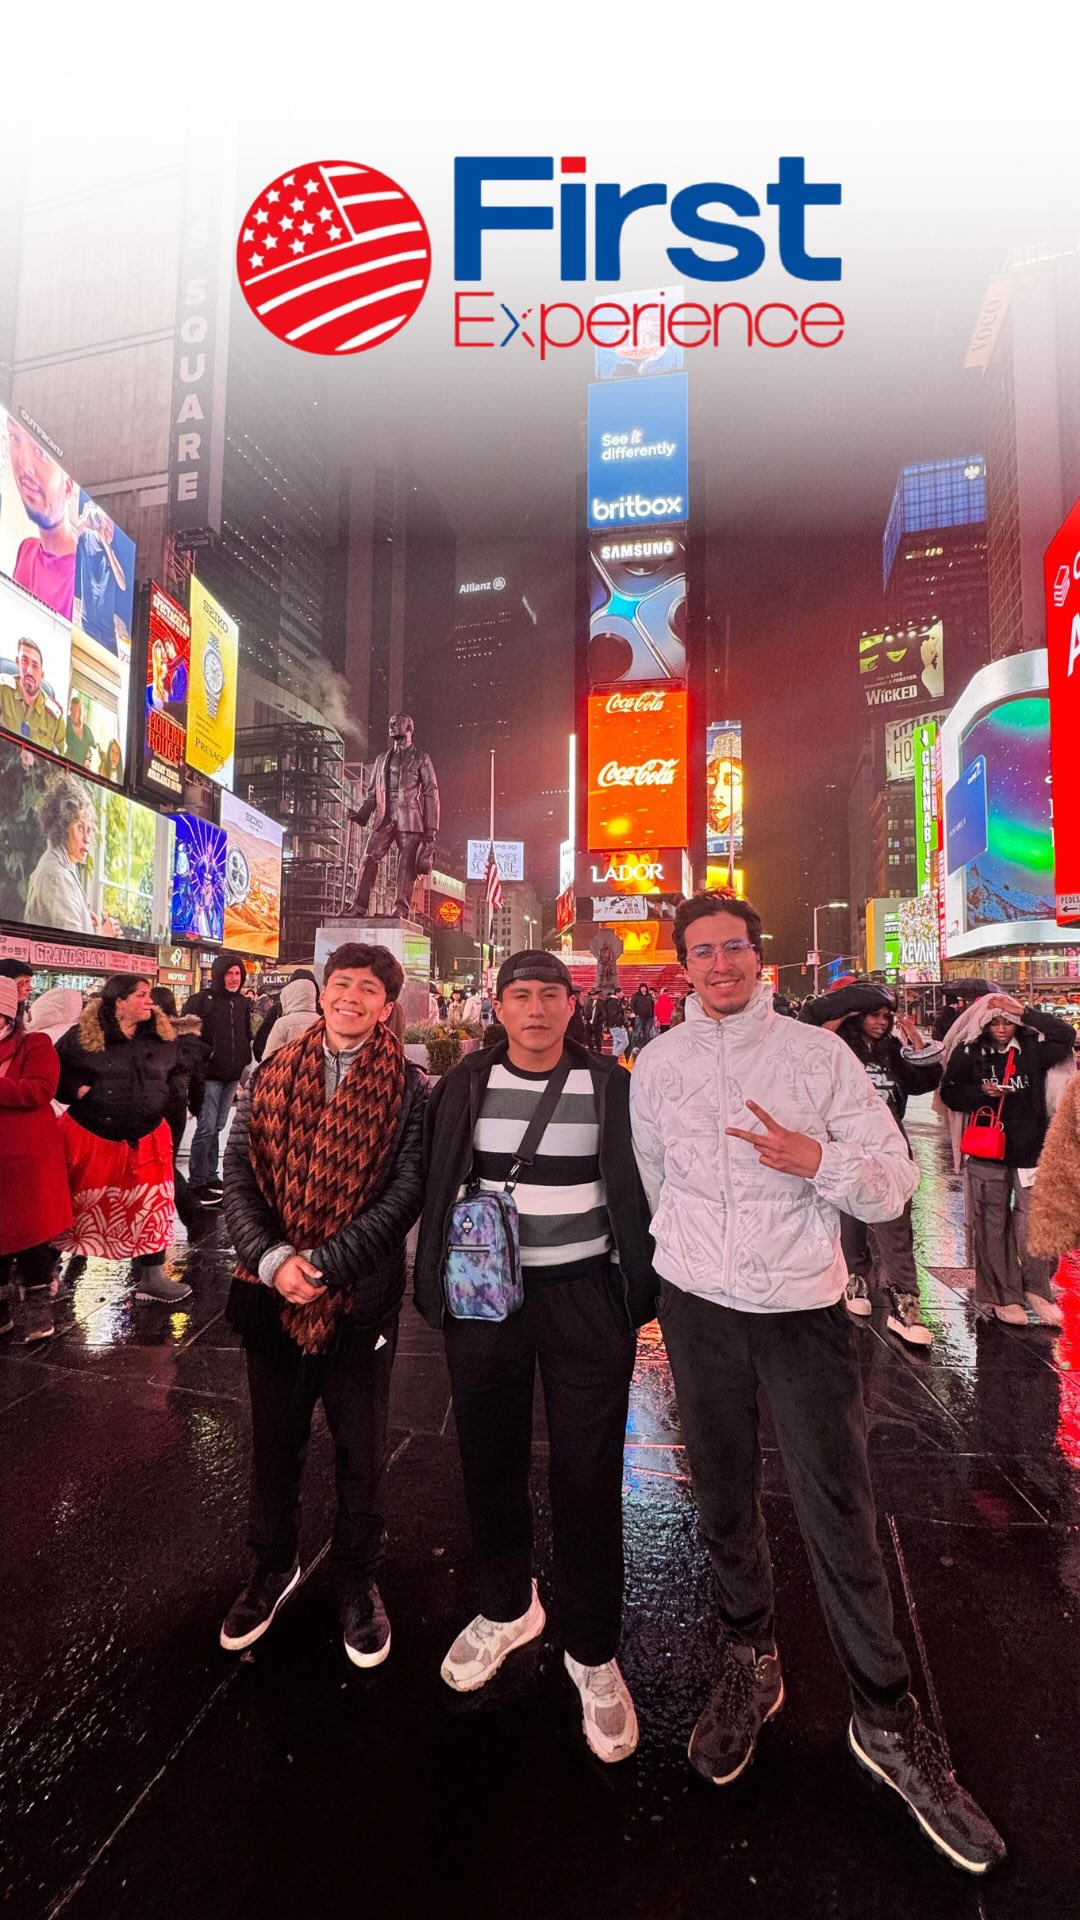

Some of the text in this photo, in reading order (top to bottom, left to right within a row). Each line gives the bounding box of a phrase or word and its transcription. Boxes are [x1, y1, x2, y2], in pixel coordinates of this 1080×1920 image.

[177, 278, 208, 501] SQUARE
[602, 429, 642, 447] See it
[602, 442, 675, 461] differently
[592, 495, 682, 521] britbox
[601, 540, 674, 560] SAMSUNG
[459, 582, 491, 594] Allianz
[203, 599, 228, 634] SEIKO
[605, 691, 667, 714] Coca-Cola
[597, 758, 680, 788] Coca-Cola
[921, 750, 931, 874] CANNABIS
[590, 863, 665, 883] LADOR
